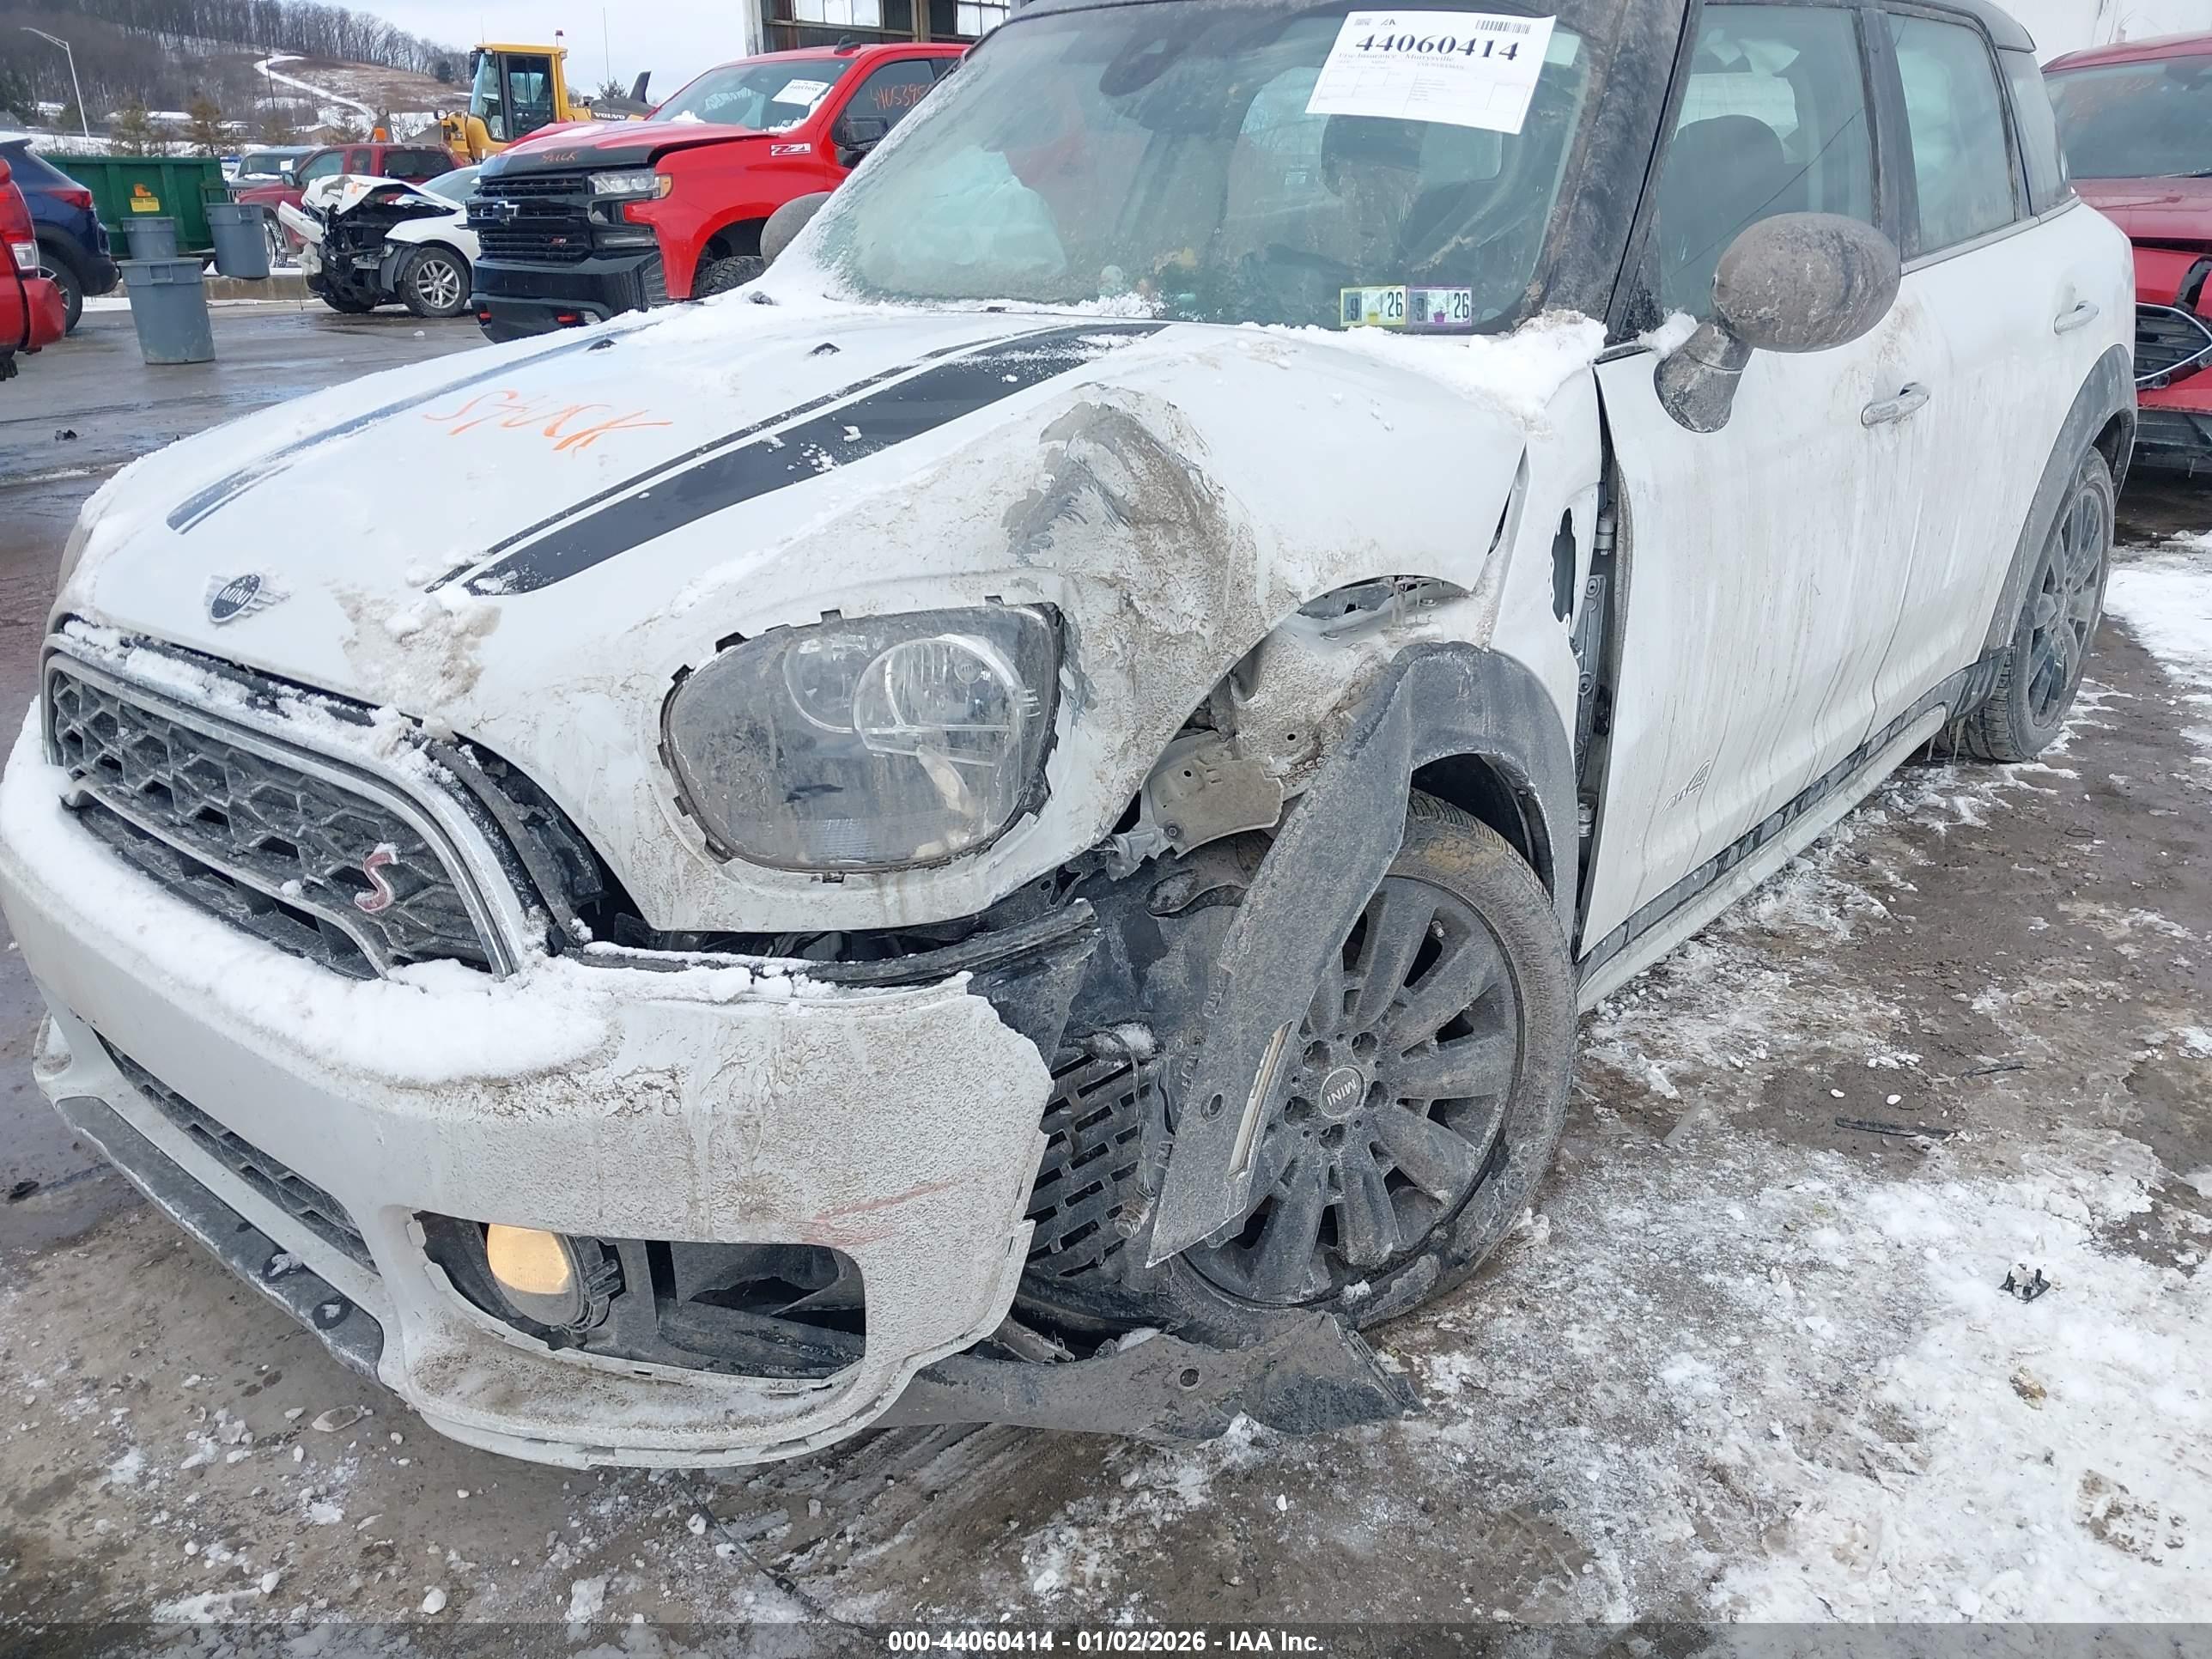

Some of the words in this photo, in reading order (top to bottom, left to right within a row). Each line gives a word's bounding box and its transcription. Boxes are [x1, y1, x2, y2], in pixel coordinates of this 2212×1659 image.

[1355, 33, 1519, 61] 44060414
[1388, 291, 1403, 318] 26
[1454, 292, 1469, 319] 26
[354, 842, 400, 913] S
[1327, 1078, 1357, 1107] MINI
